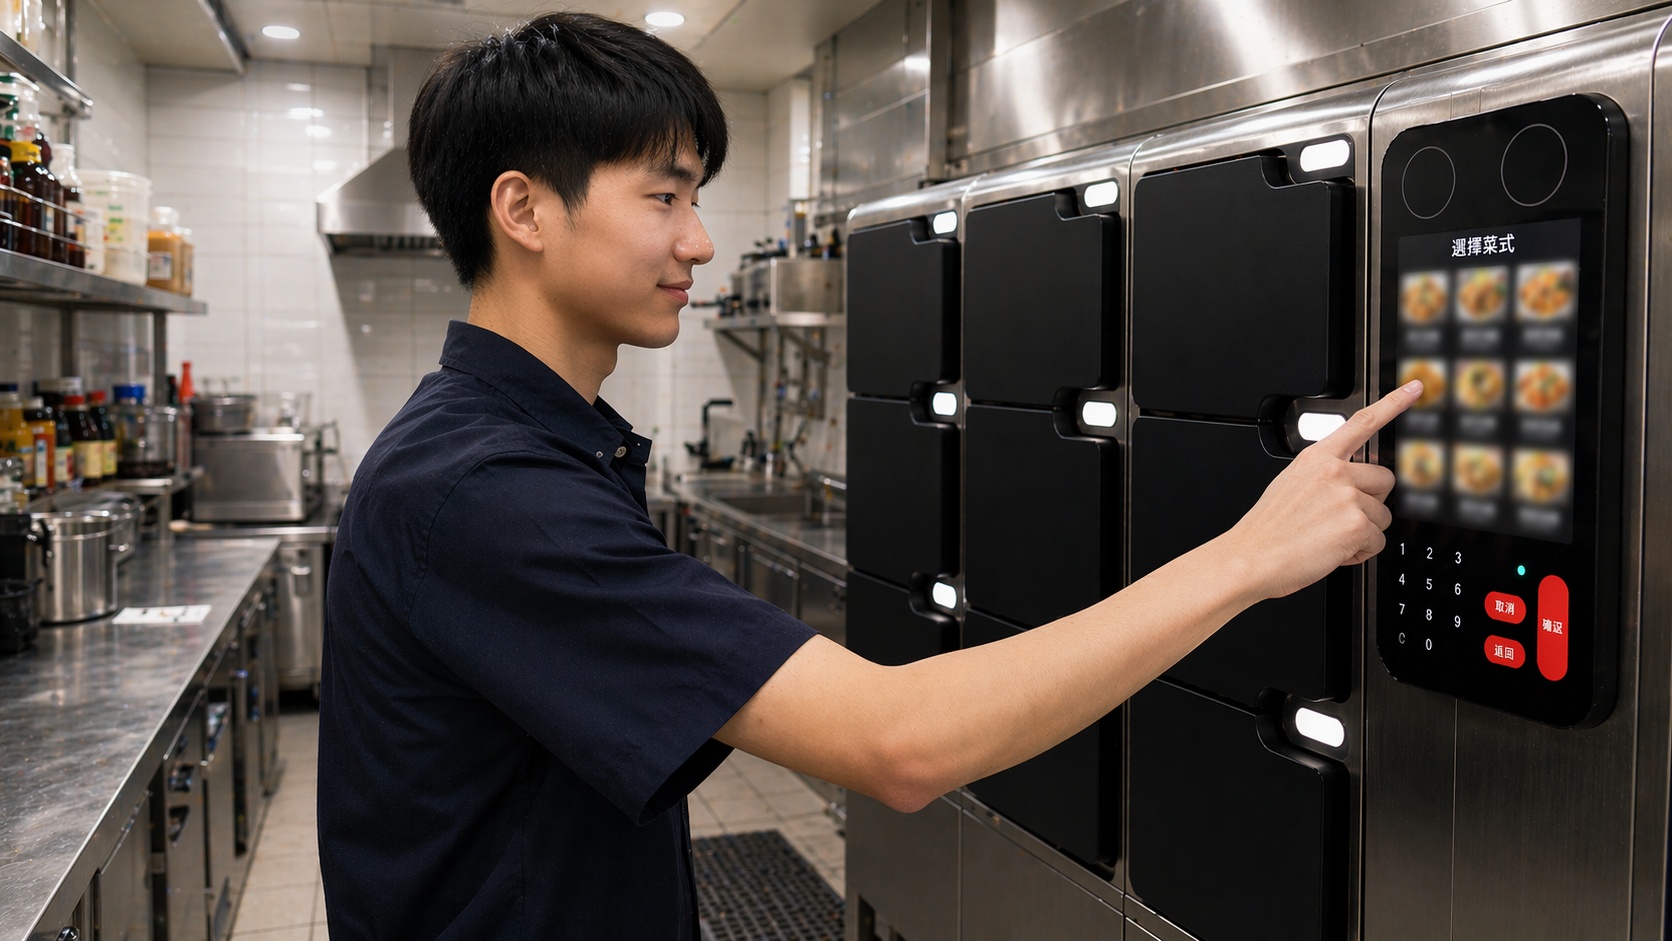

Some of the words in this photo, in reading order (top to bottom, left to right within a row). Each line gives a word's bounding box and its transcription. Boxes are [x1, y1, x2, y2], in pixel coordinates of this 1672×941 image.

[1451, 233, 1515, 258] 選擇菜式
[1400, 542, 1405, 555] 1
[1426, 547, 1433, 560] 2
[1455, 551, 1462, 564] 3
[1399, 573, 1406, 585] 4
[1426, 578, 1433, 590] 5
[1454, 583, 1461, 595] 6
[1399, 603, 1406, 615] 7
[1425, 609, 1433, 621] 8
[1454, 615, 1461, 628] 9
[1398, 632, 1406, 644] C
[1425, 638, 1433, 651] 0
